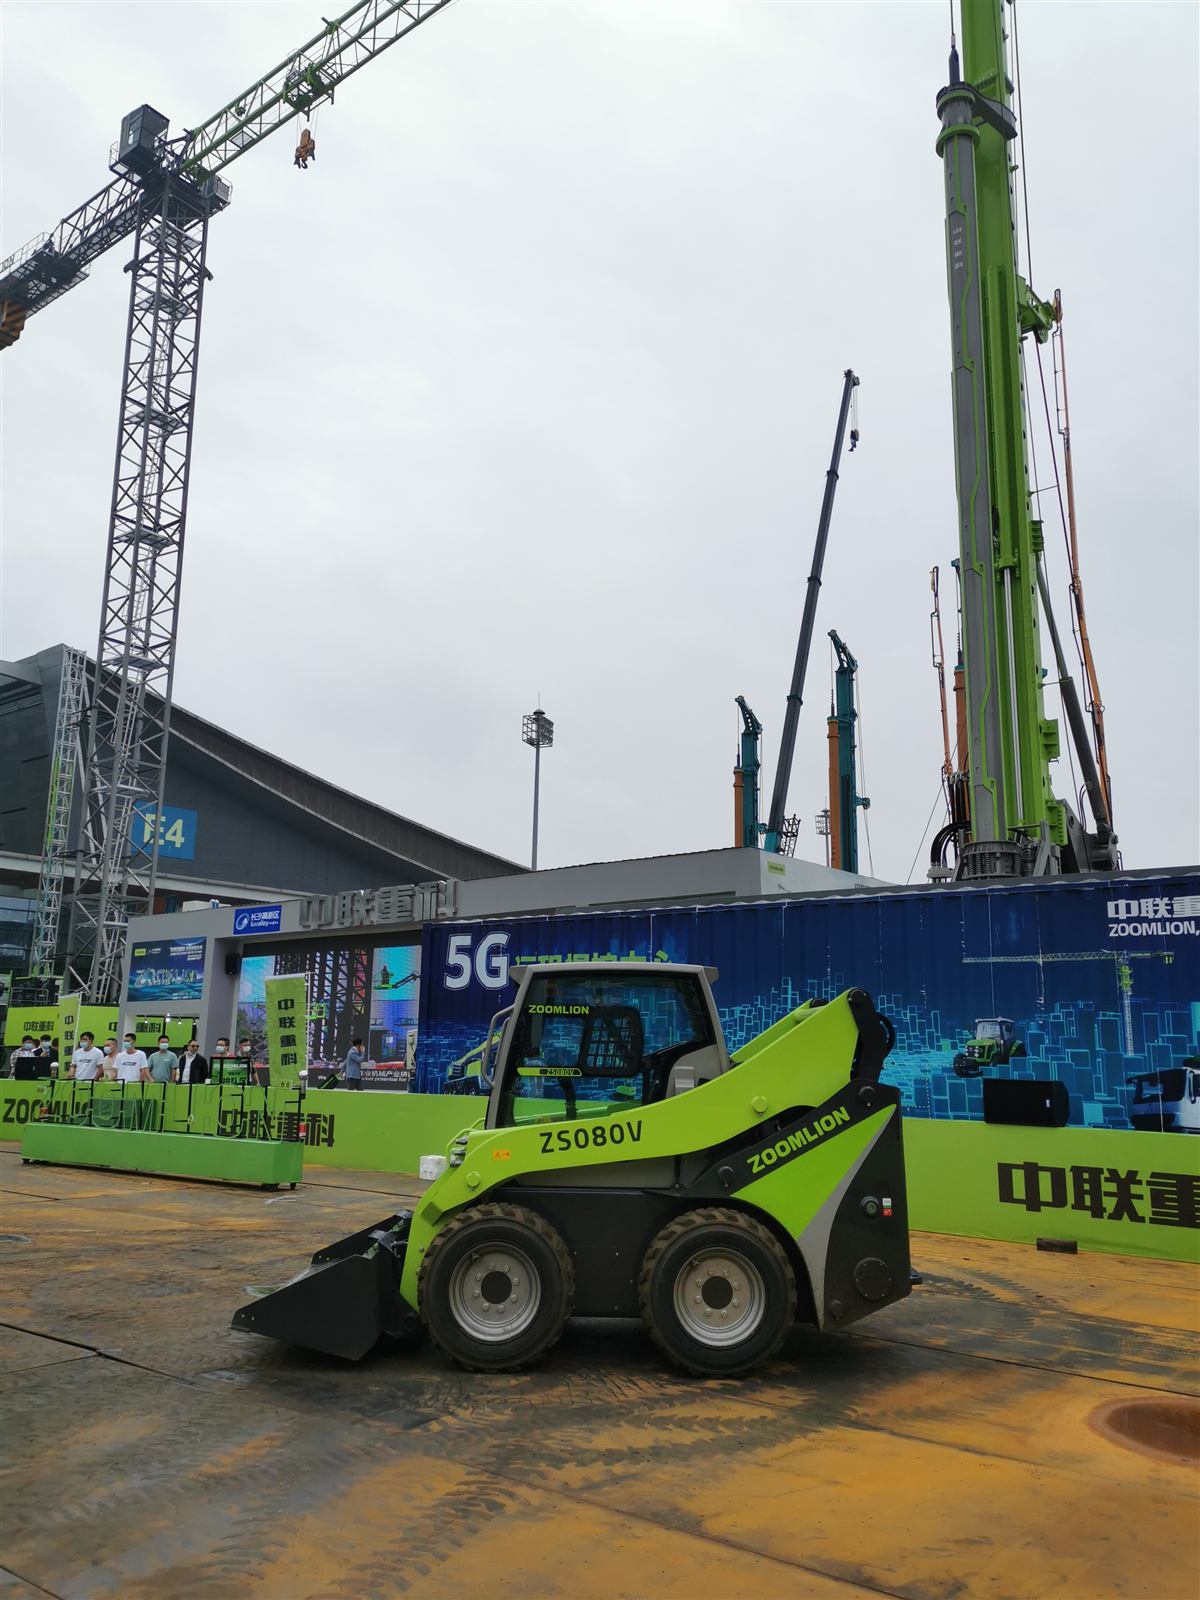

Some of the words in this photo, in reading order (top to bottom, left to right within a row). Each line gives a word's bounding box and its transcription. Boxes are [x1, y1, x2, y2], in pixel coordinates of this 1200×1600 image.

[143, 812, 185, 848] E4
[445, 931, 511, 990] 5G
[528, 1004, 590, 1015] ZOOMLION
[539, 1120, 642, 1153] ZS080V
[746, 1105, 851, 1174] ZOOMLION
